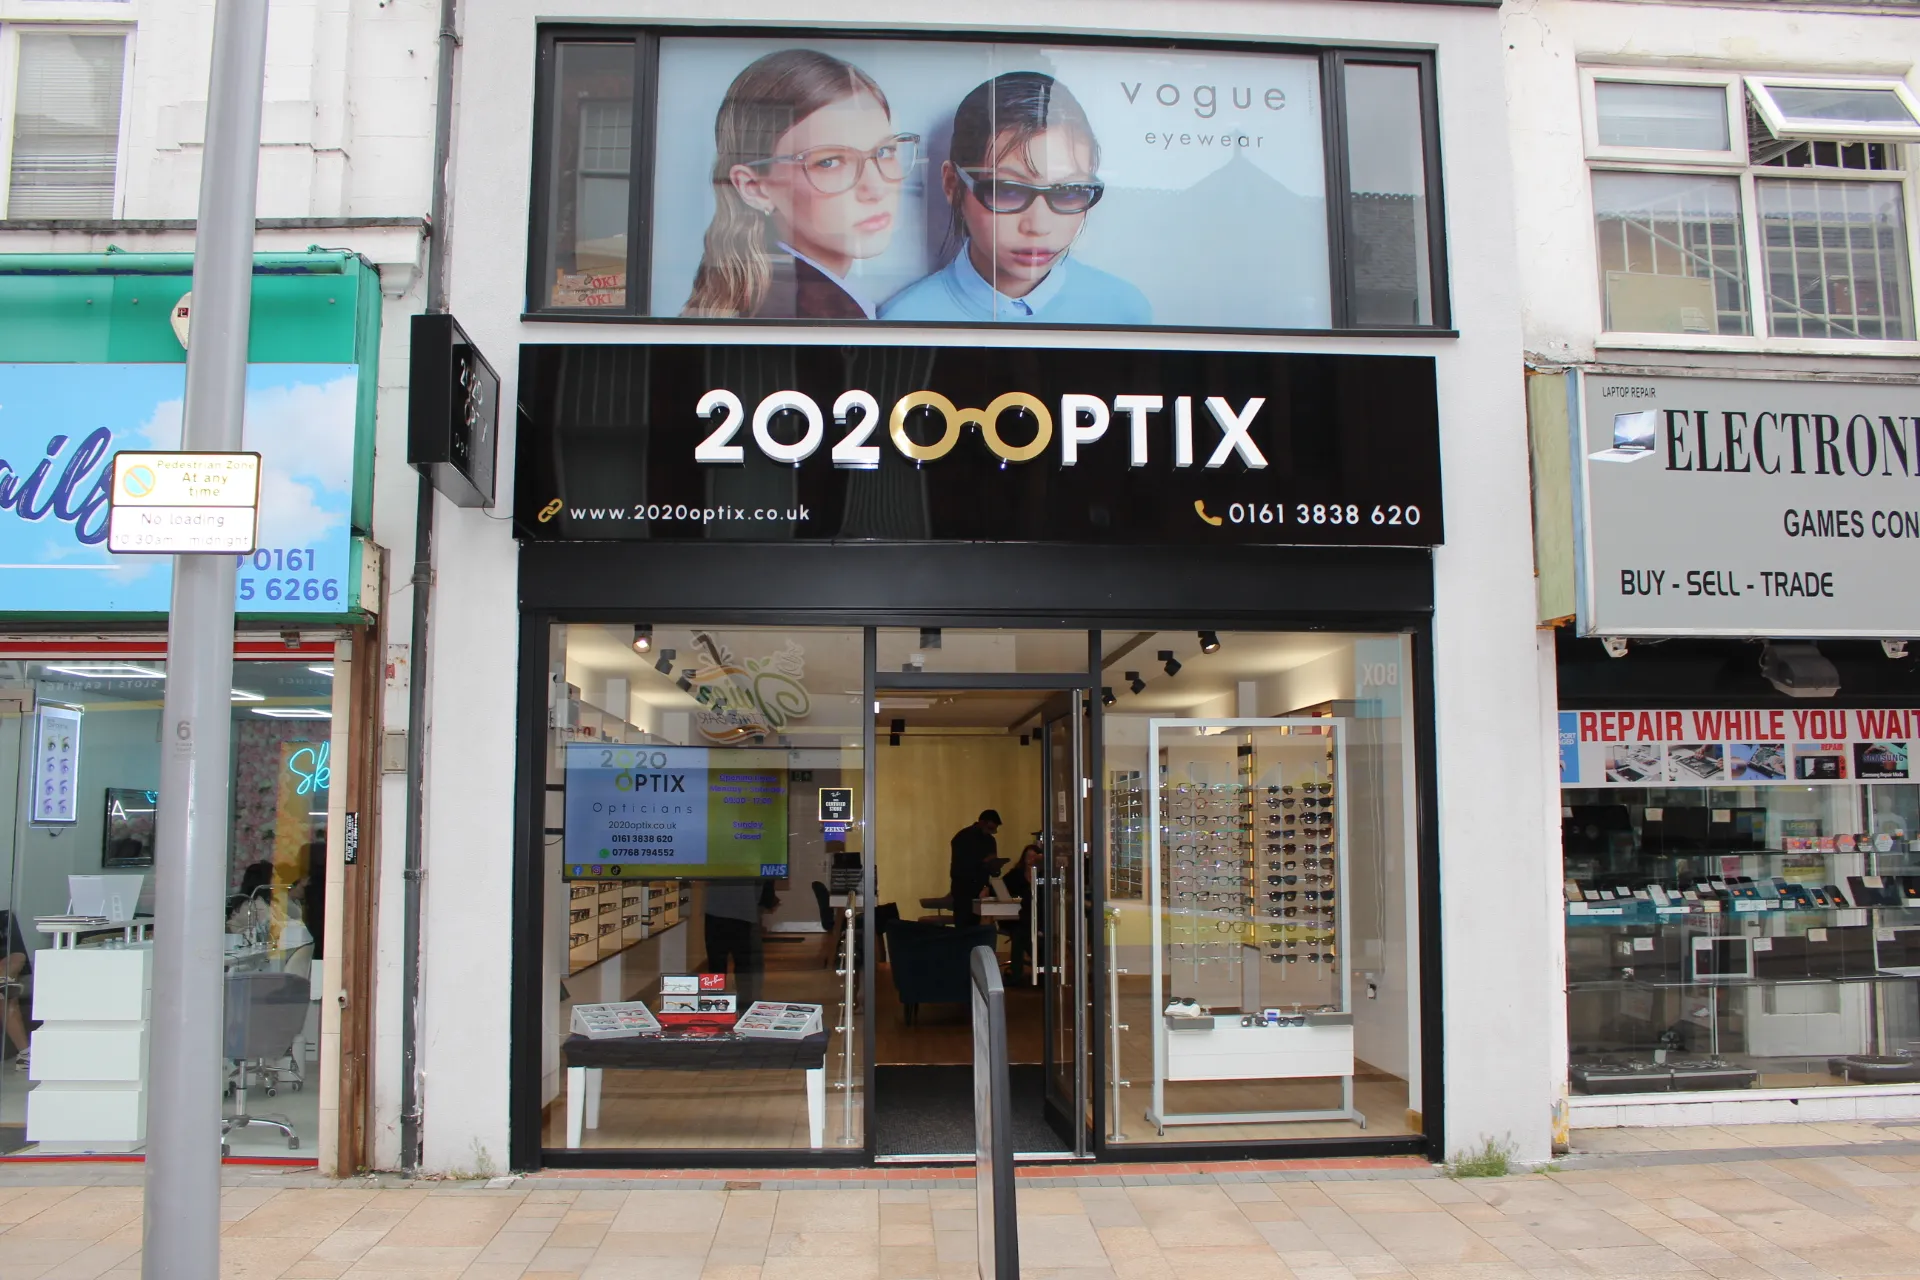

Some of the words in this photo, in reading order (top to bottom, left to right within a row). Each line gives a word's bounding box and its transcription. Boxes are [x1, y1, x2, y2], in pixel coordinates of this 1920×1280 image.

[1120, 82, 1286, 118] vogue
[1145, 132, 1264, 150] eyewear
[592, 275, 618, 288] OKI
[585, 293, 612, 306] OKI
[1602, 386, 1629, 398] LAPTOP
[1631, 387, 1656, 398] REPAIR
[157, 459, 221, 470] Pedestrian
[226, 460, 255, 470] Zone
[182, 472, 197, 483] At
[204, 474, 228, 485] any
[189, 486, 221, 497] time
[141, 513, 162, 525] No
[170, 513, 225, 528] loading
[570, 504, 811, 525] www.2020optix.co.uk
[1228, 503, 1284, 524] 0161
[1296, 503, 1360, 525] 3838
[1371, 505, 1420, 526] 620
[1783, 509, 1864, 538] GAMES
[1871, 511, 1920, 538] CON
[253, 548, 315, 571] 0161
[266, 578, 338, 601] 6266
[1620, 569, 1665, 596] BUY
[1687, 570, 1740, 597] SELL
[1760, 572, 1834, 597] TRADE
[176, 721, 191, 740] 6
[1580, 711, 1683, 742] REPAIR
[1693, 710, 1786, 740] WHILE
[1792, 710, 1847, 739] YOU
[1855, 709, 1920, 739] WAIT
[1863, 754, 1905, 762] SAMSUNG
[615, 773, 685, 793] OPTIX
[593, 802, 693, 816] Opticians
[608, 820, 677, 831] 2020optix.co.uk
[611, 835, 630, 843] 0161
[632, 835, 654, 843] 3838
[656, 835, 673, 843] 620
[612, 848, 639, 857] 07768
[641, 848, 674, 857] 794552
[761, 865, 786, 876] NHS
[700, 974, 724, 987] Ray-Ban
